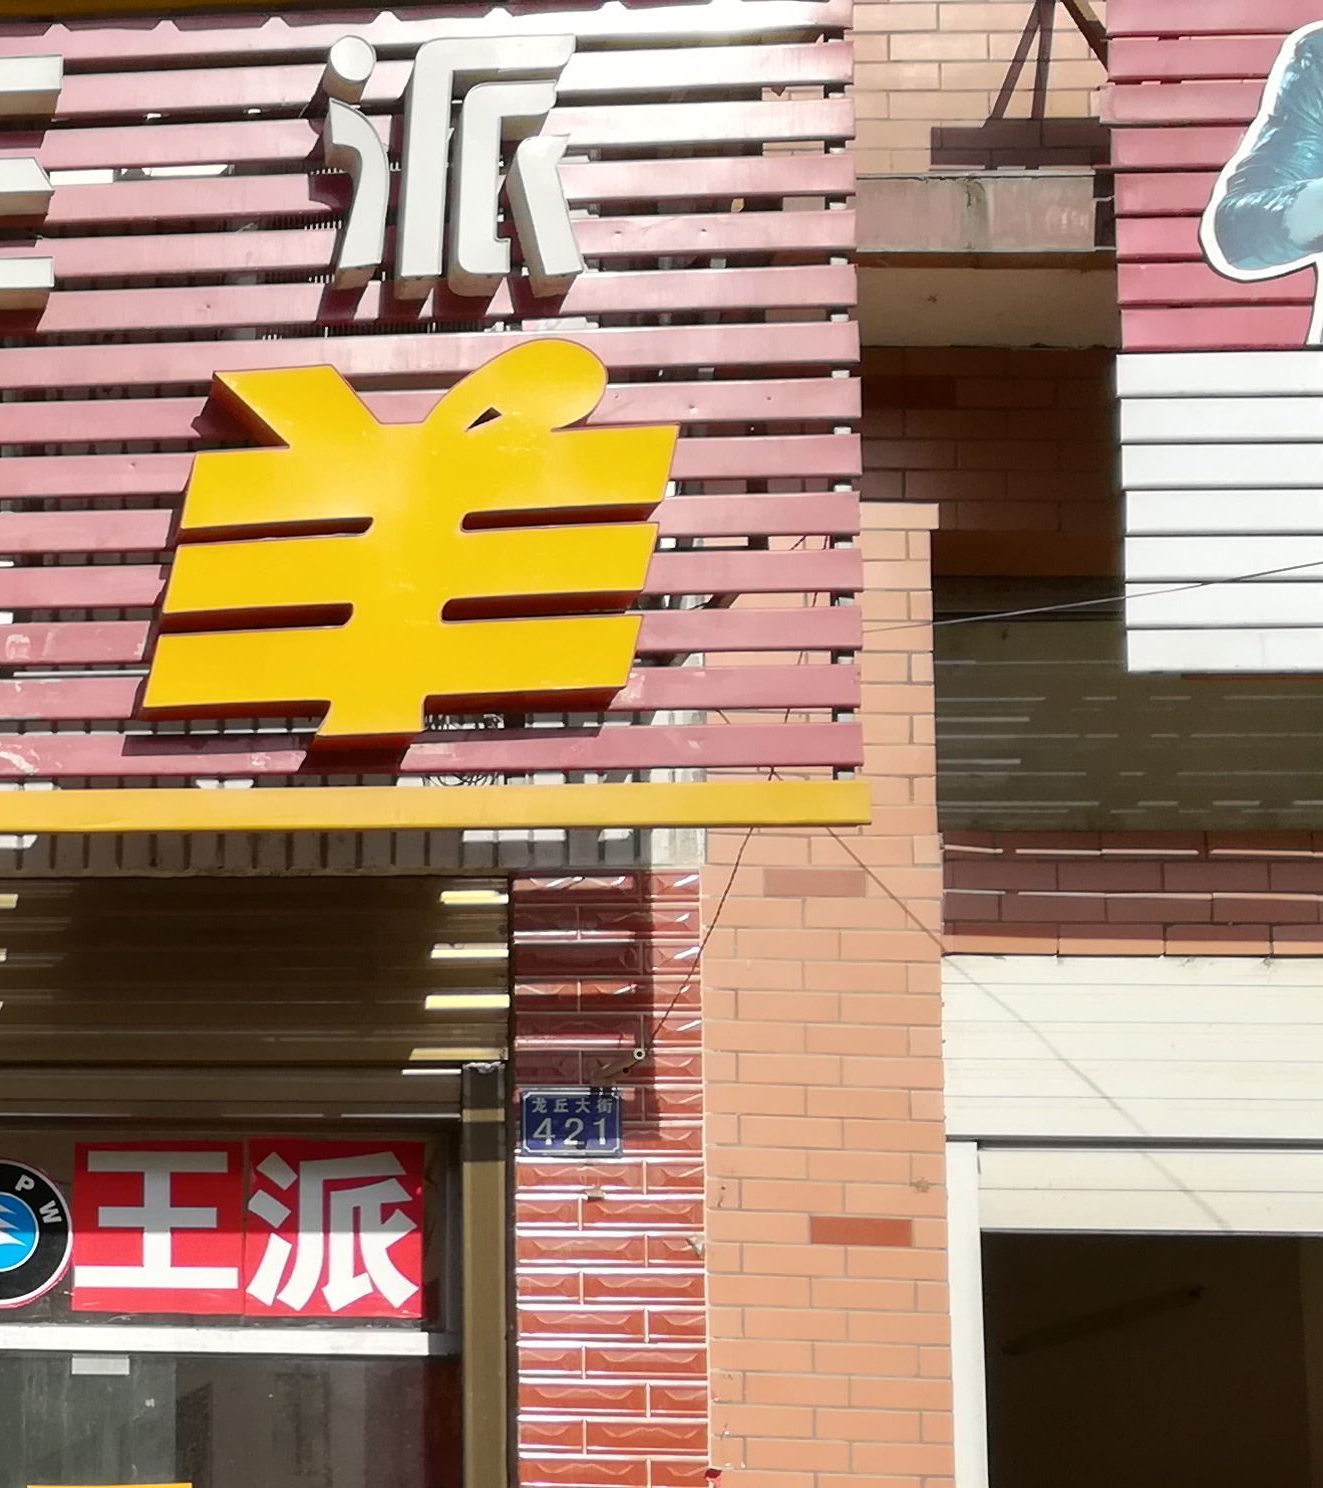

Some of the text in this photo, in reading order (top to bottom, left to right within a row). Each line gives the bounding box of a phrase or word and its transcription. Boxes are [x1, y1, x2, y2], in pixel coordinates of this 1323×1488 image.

[531, 1098, 613, 1113] 龙丘大街
[533, 1118, 606, 1145] 421
[76, 1150, 420, 1312] 王派
